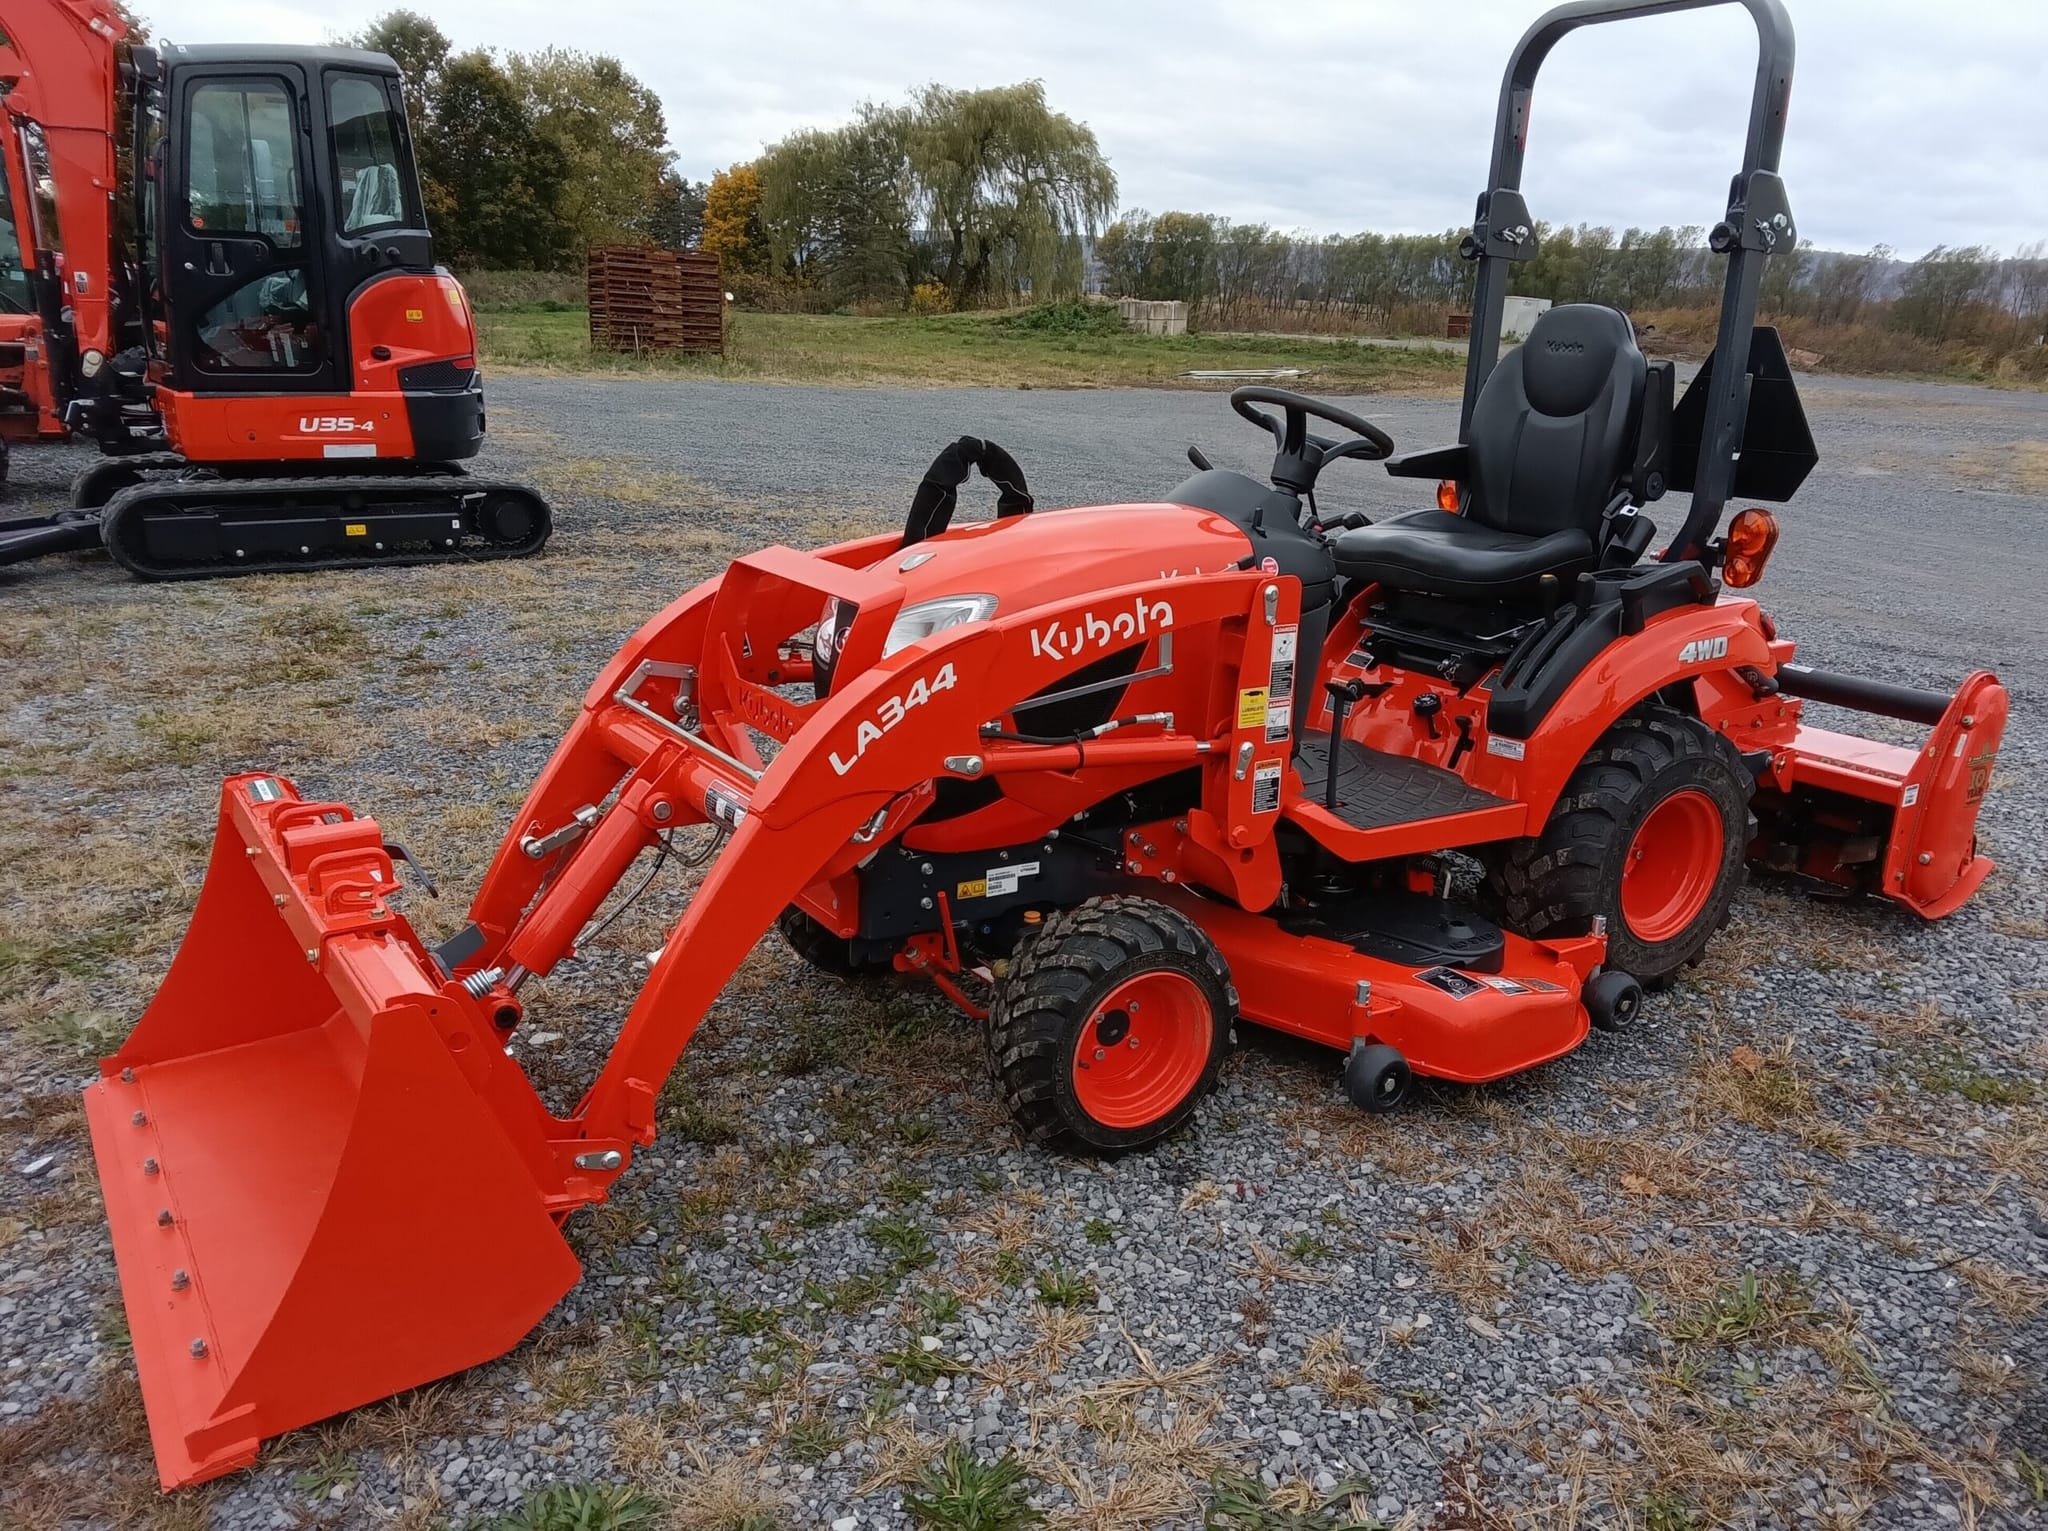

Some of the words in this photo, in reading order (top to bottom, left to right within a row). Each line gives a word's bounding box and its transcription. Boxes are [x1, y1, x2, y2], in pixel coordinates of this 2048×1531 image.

[299, 417, 375, 432] U35-4
[1030, 597, 1174, 661] Kubota
[1678, 636, 1729, 663] 4WD
[828, 662, 958, 775] LA344
